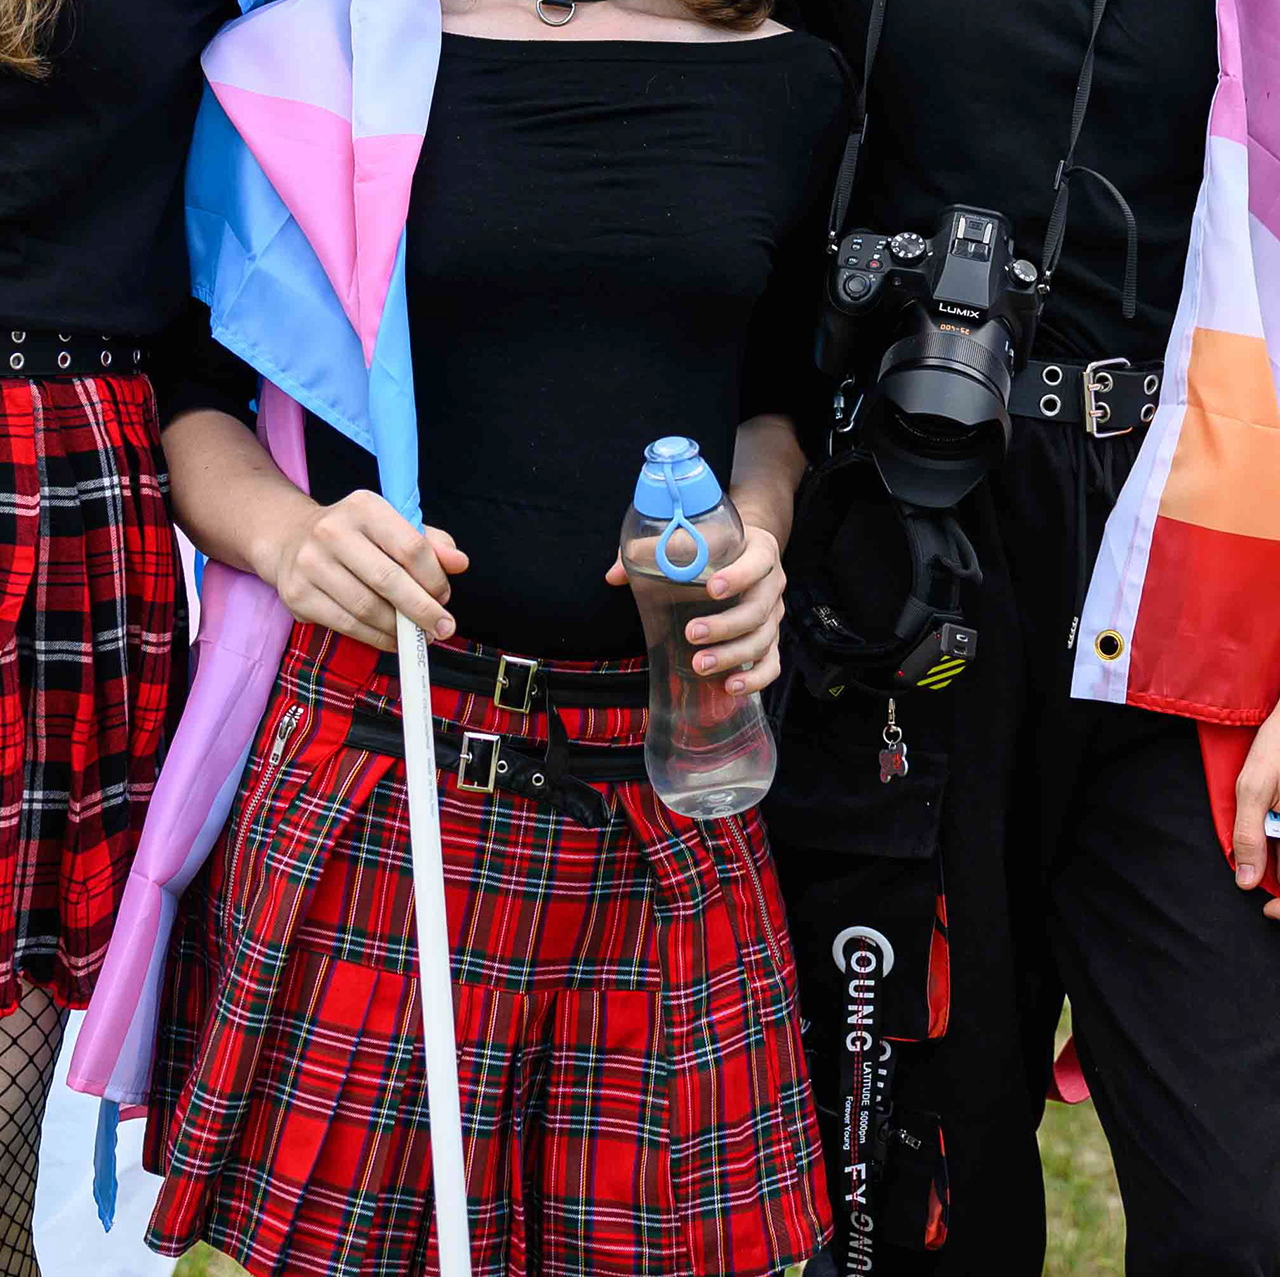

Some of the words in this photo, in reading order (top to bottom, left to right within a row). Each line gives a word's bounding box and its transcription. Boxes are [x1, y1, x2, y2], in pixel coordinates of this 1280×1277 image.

[938, 302, 980, 319] LUMIX
[846, 937, 877, 1053] OUNG
[861, 1062, 872, 1107] LATITUDE
[845, 1096, 854, 1124] Forever
[859, 1110, 870, 1145] 5000pm
[843, 1124, 852, 1152] Young
[846, 1211, 874, 1277] UNG
